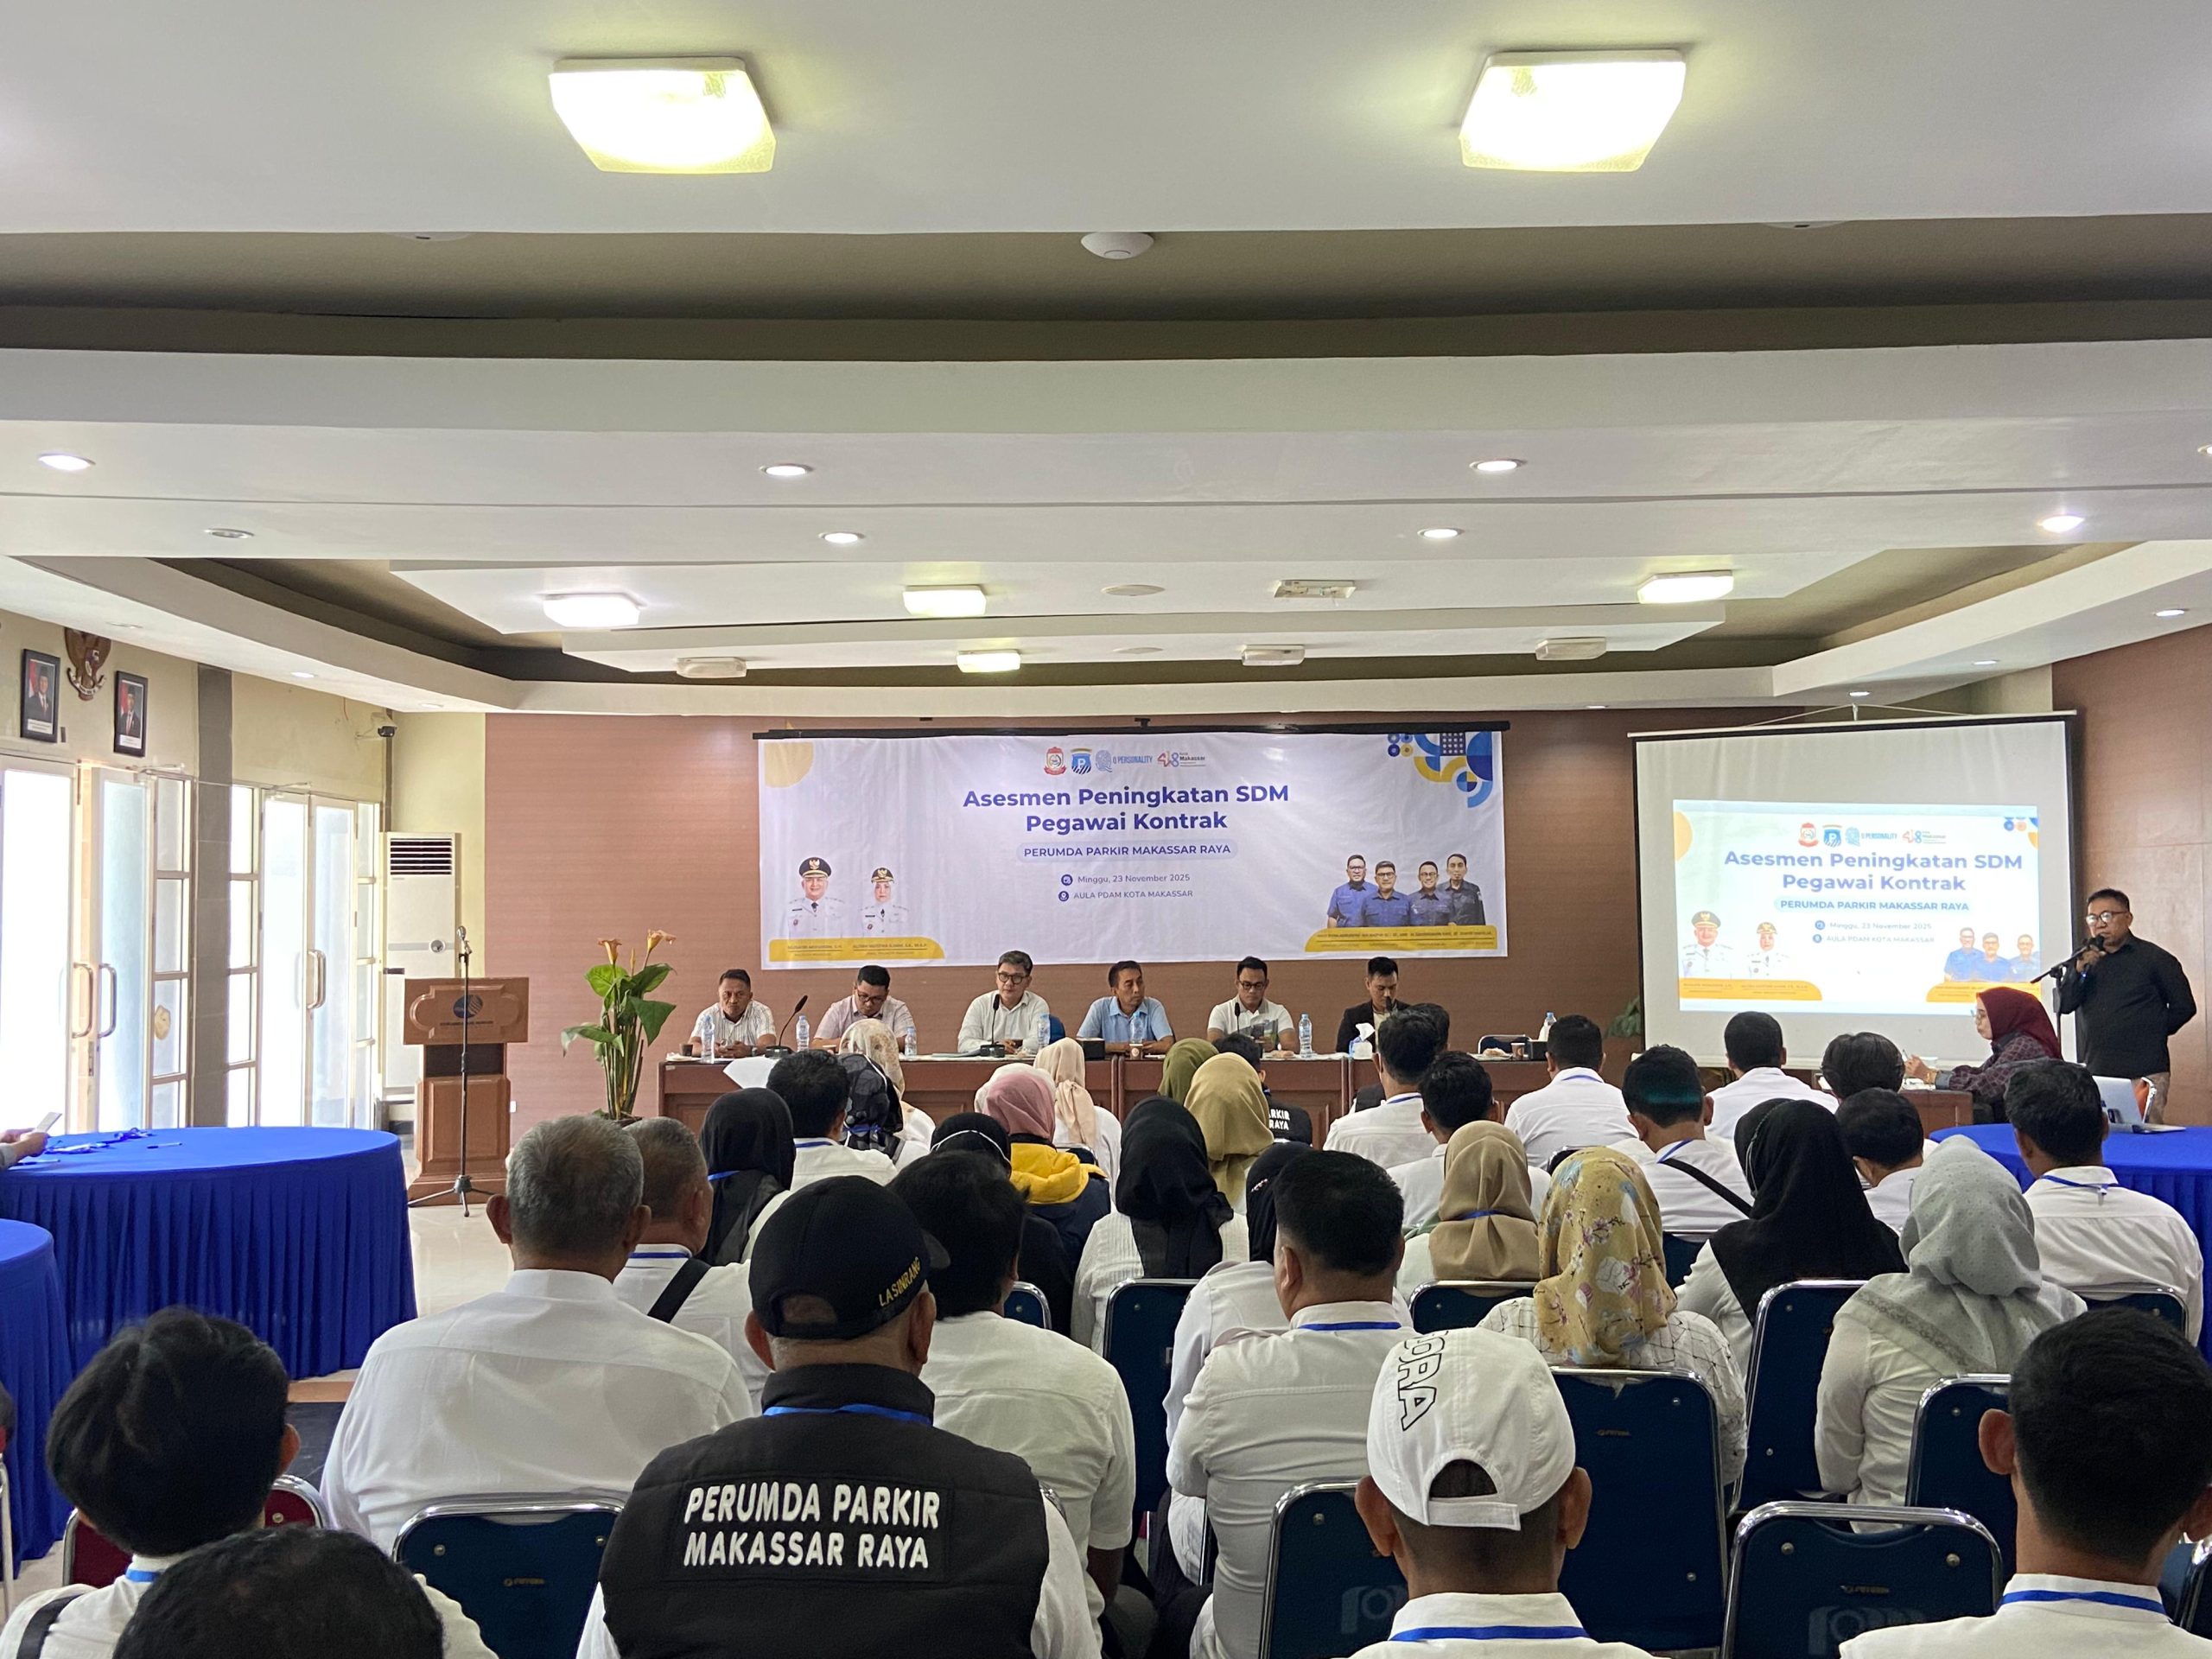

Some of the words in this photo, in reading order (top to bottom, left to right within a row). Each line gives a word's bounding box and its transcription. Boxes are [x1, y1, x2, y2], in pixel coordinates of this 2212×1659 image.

[1117, 755, 1154, 765] PERSONALITY
[963, 790, 1071, 808] Asesmen
[1078, 786, 1230, 808] Peningkatan
[1236, 785, 1289, 803] SDM
[1026, 812, 1126, 836] Pegawai
[1134, 811, 1228, 830] Kontrak
[1024, 847, 1083, 857] PERUMDA
[1086, 846, 1128, 856] PARKIR
[1132, 845, 1197, 855] MAKASSAR
[1200, 844, 1231, 854] RAYA
[1724, 851, 1823, 868] Asesmen
[1830, 852, 1967, 871] Peningkatan
[1974, 854, 2023, 869] SDM
[1077, 875, 1111, 885] Minggu,
[1782, 874, 1873, 893] Pegawai
[1880, 874, 1966, 891] Kontrak
[1780, 900, 1834, 909] PERUMDA
[1837, 901, 1877, 910] PARKIR
[1878, 901, 1938, 910] MAKASSAR
[1941, 902, 1969, 911] RAYA
[1269, 1109, 1291, 1121] RKIR
[1269, 1119, 1289, 1130] RAYA
[683, 1481, 821, 1524] PERUMDA
[832, 1484, 941, 1529] PARKIR
[683, 1530, 845, 1567] MAKASSAR
[857, 1533, 930, 1569] RAYA
